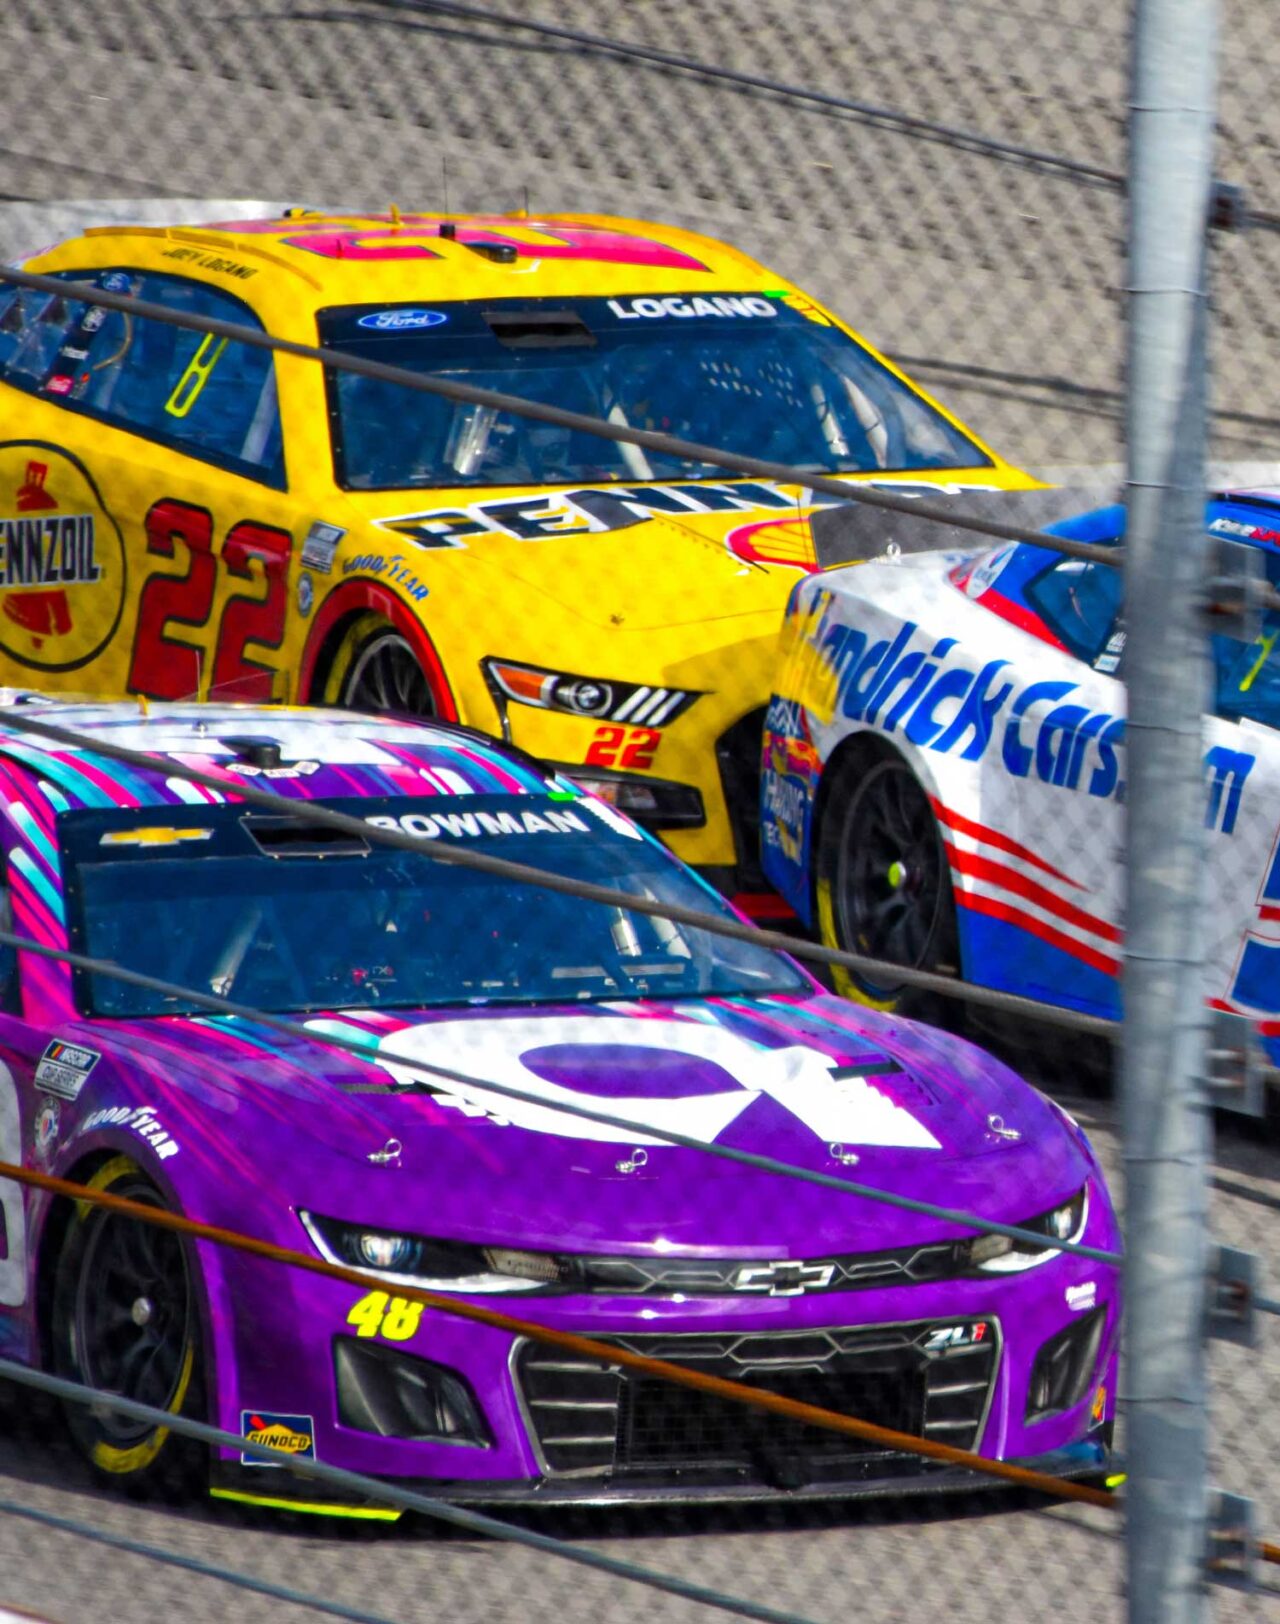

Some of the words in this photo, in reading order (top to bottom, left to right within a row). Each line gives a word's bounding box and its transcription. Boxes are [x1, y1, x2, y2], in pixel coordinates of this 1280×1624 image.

[606, 297, 778, 319] LOGANO
[126, 497, 293, 706] 22
[585, 725, 662, 770] 22
[347, 1289, 424, 1341] 48
